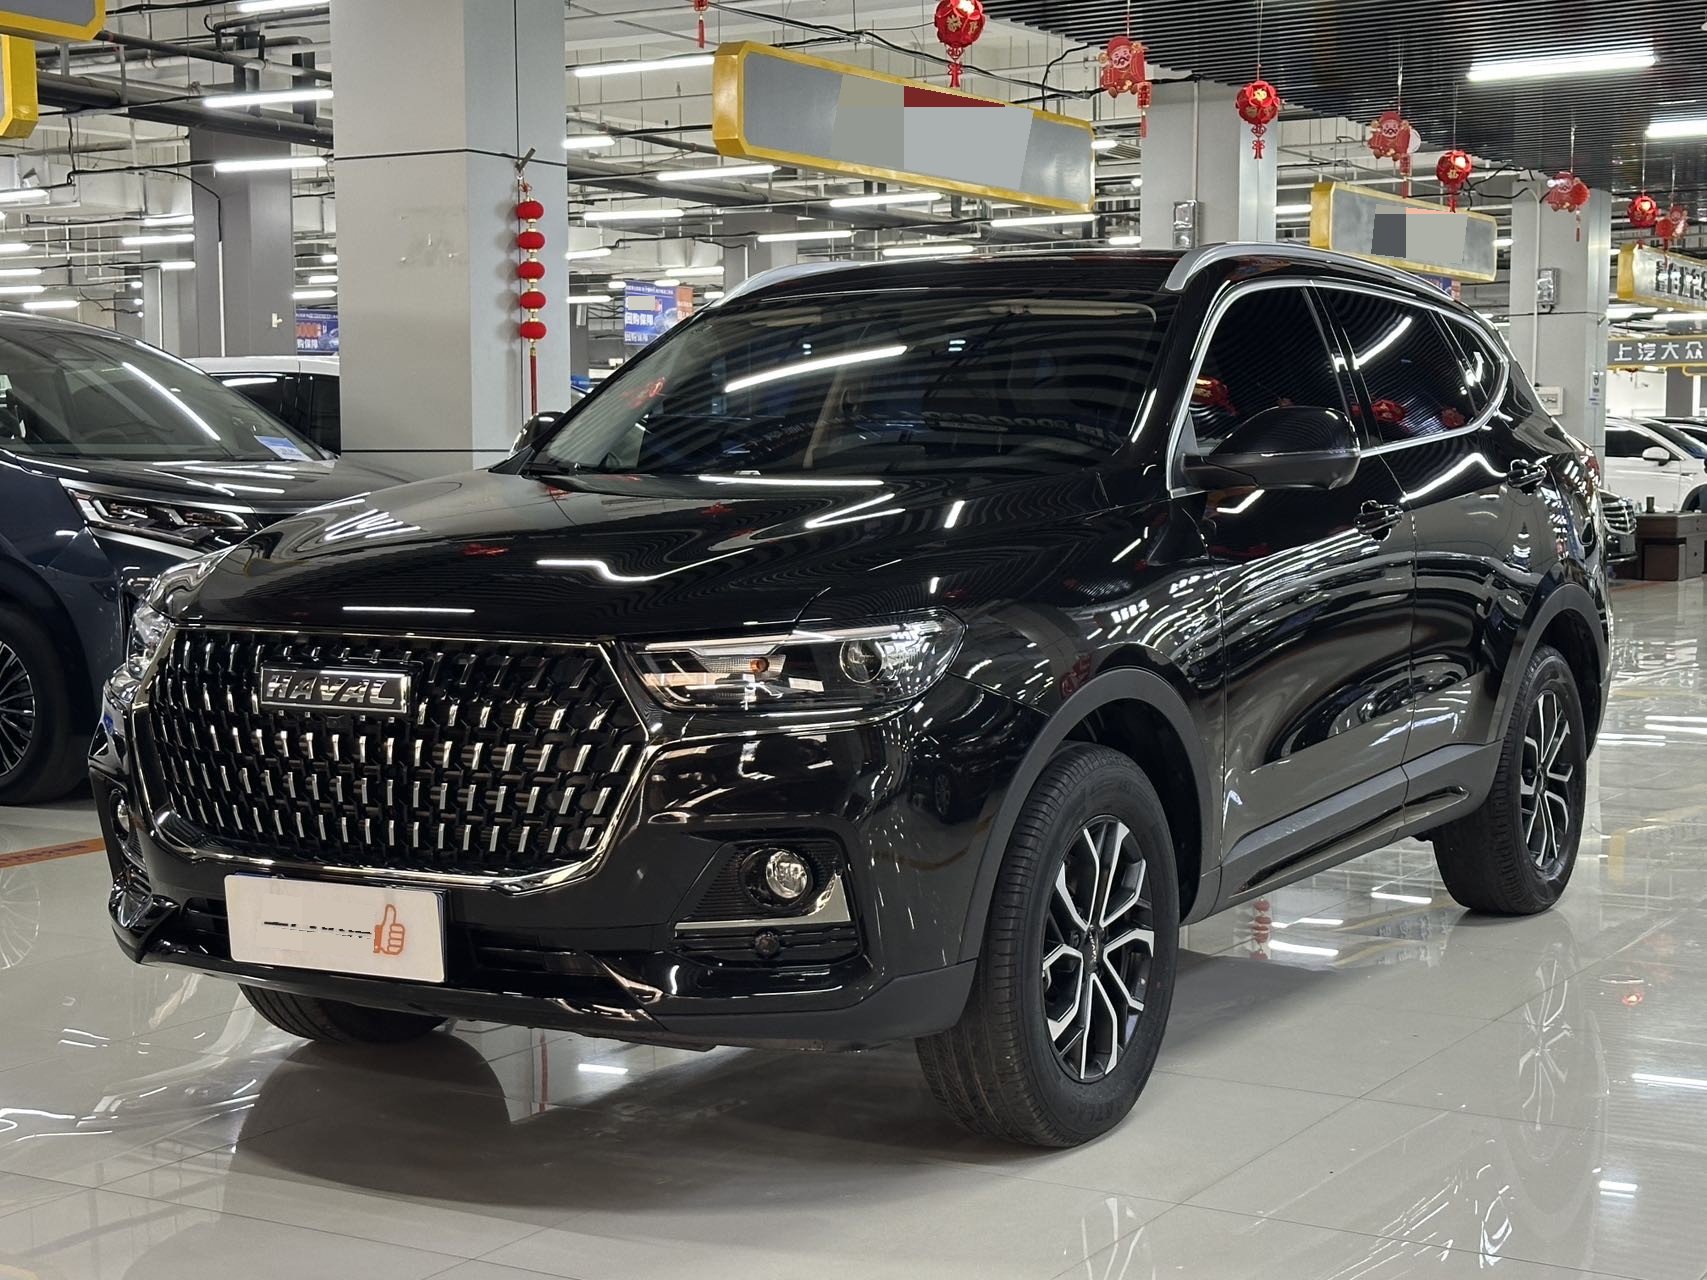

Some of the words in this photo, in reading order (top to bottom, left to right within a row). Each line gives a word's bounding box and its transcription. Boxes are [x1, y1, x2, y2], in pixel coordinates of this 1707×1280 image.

[1614, 341, 1703, 361] 上汽大众
[266, 674, 395, 704] HAVAL
